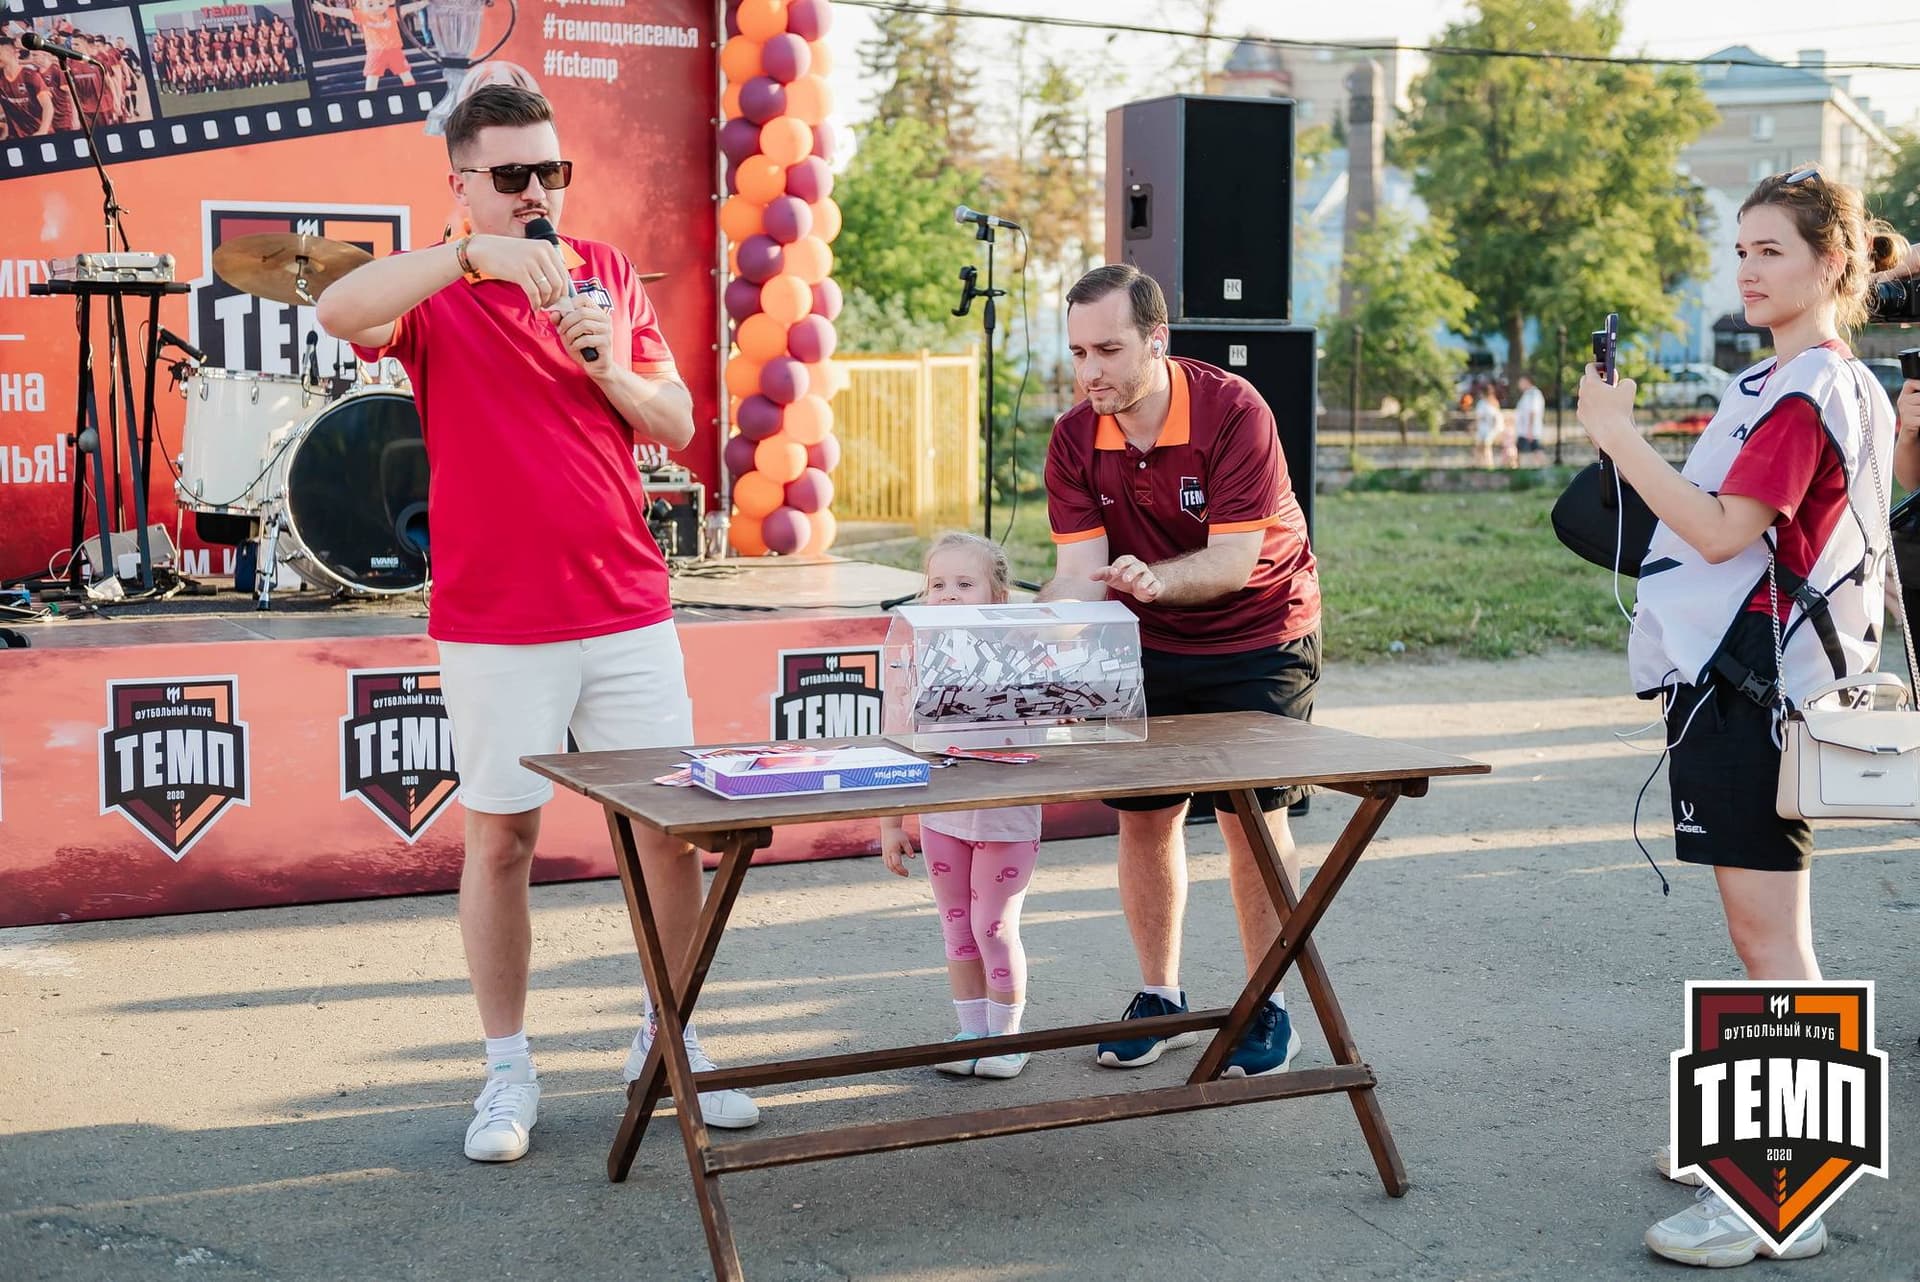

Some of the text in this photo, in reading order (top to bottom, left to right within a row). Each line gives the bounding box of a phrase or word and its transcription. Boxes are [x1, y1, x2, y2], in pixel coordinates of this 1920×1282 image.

[201, 4, 248, 18] ТЕМП
[543, 13, 699, 48] #темподнасемья
[544, 50, 619, 83] #fctemp
[214, 293, 358, 382] ТЕМ
[371, 557, 398, 565] EVANS
[373, 693, 423, 709] ФУТБОЛЬНЫЙ
[135, 704, 212, 720] ФУТБОЛЬНЫЙ КЛУБ
[783, 693, 880, 740] ТЕМП
[114, 729, 235, 793] ТЕМП
[402, 775, 418, 785] 2020
[166, 790, 185, 800] 2020
